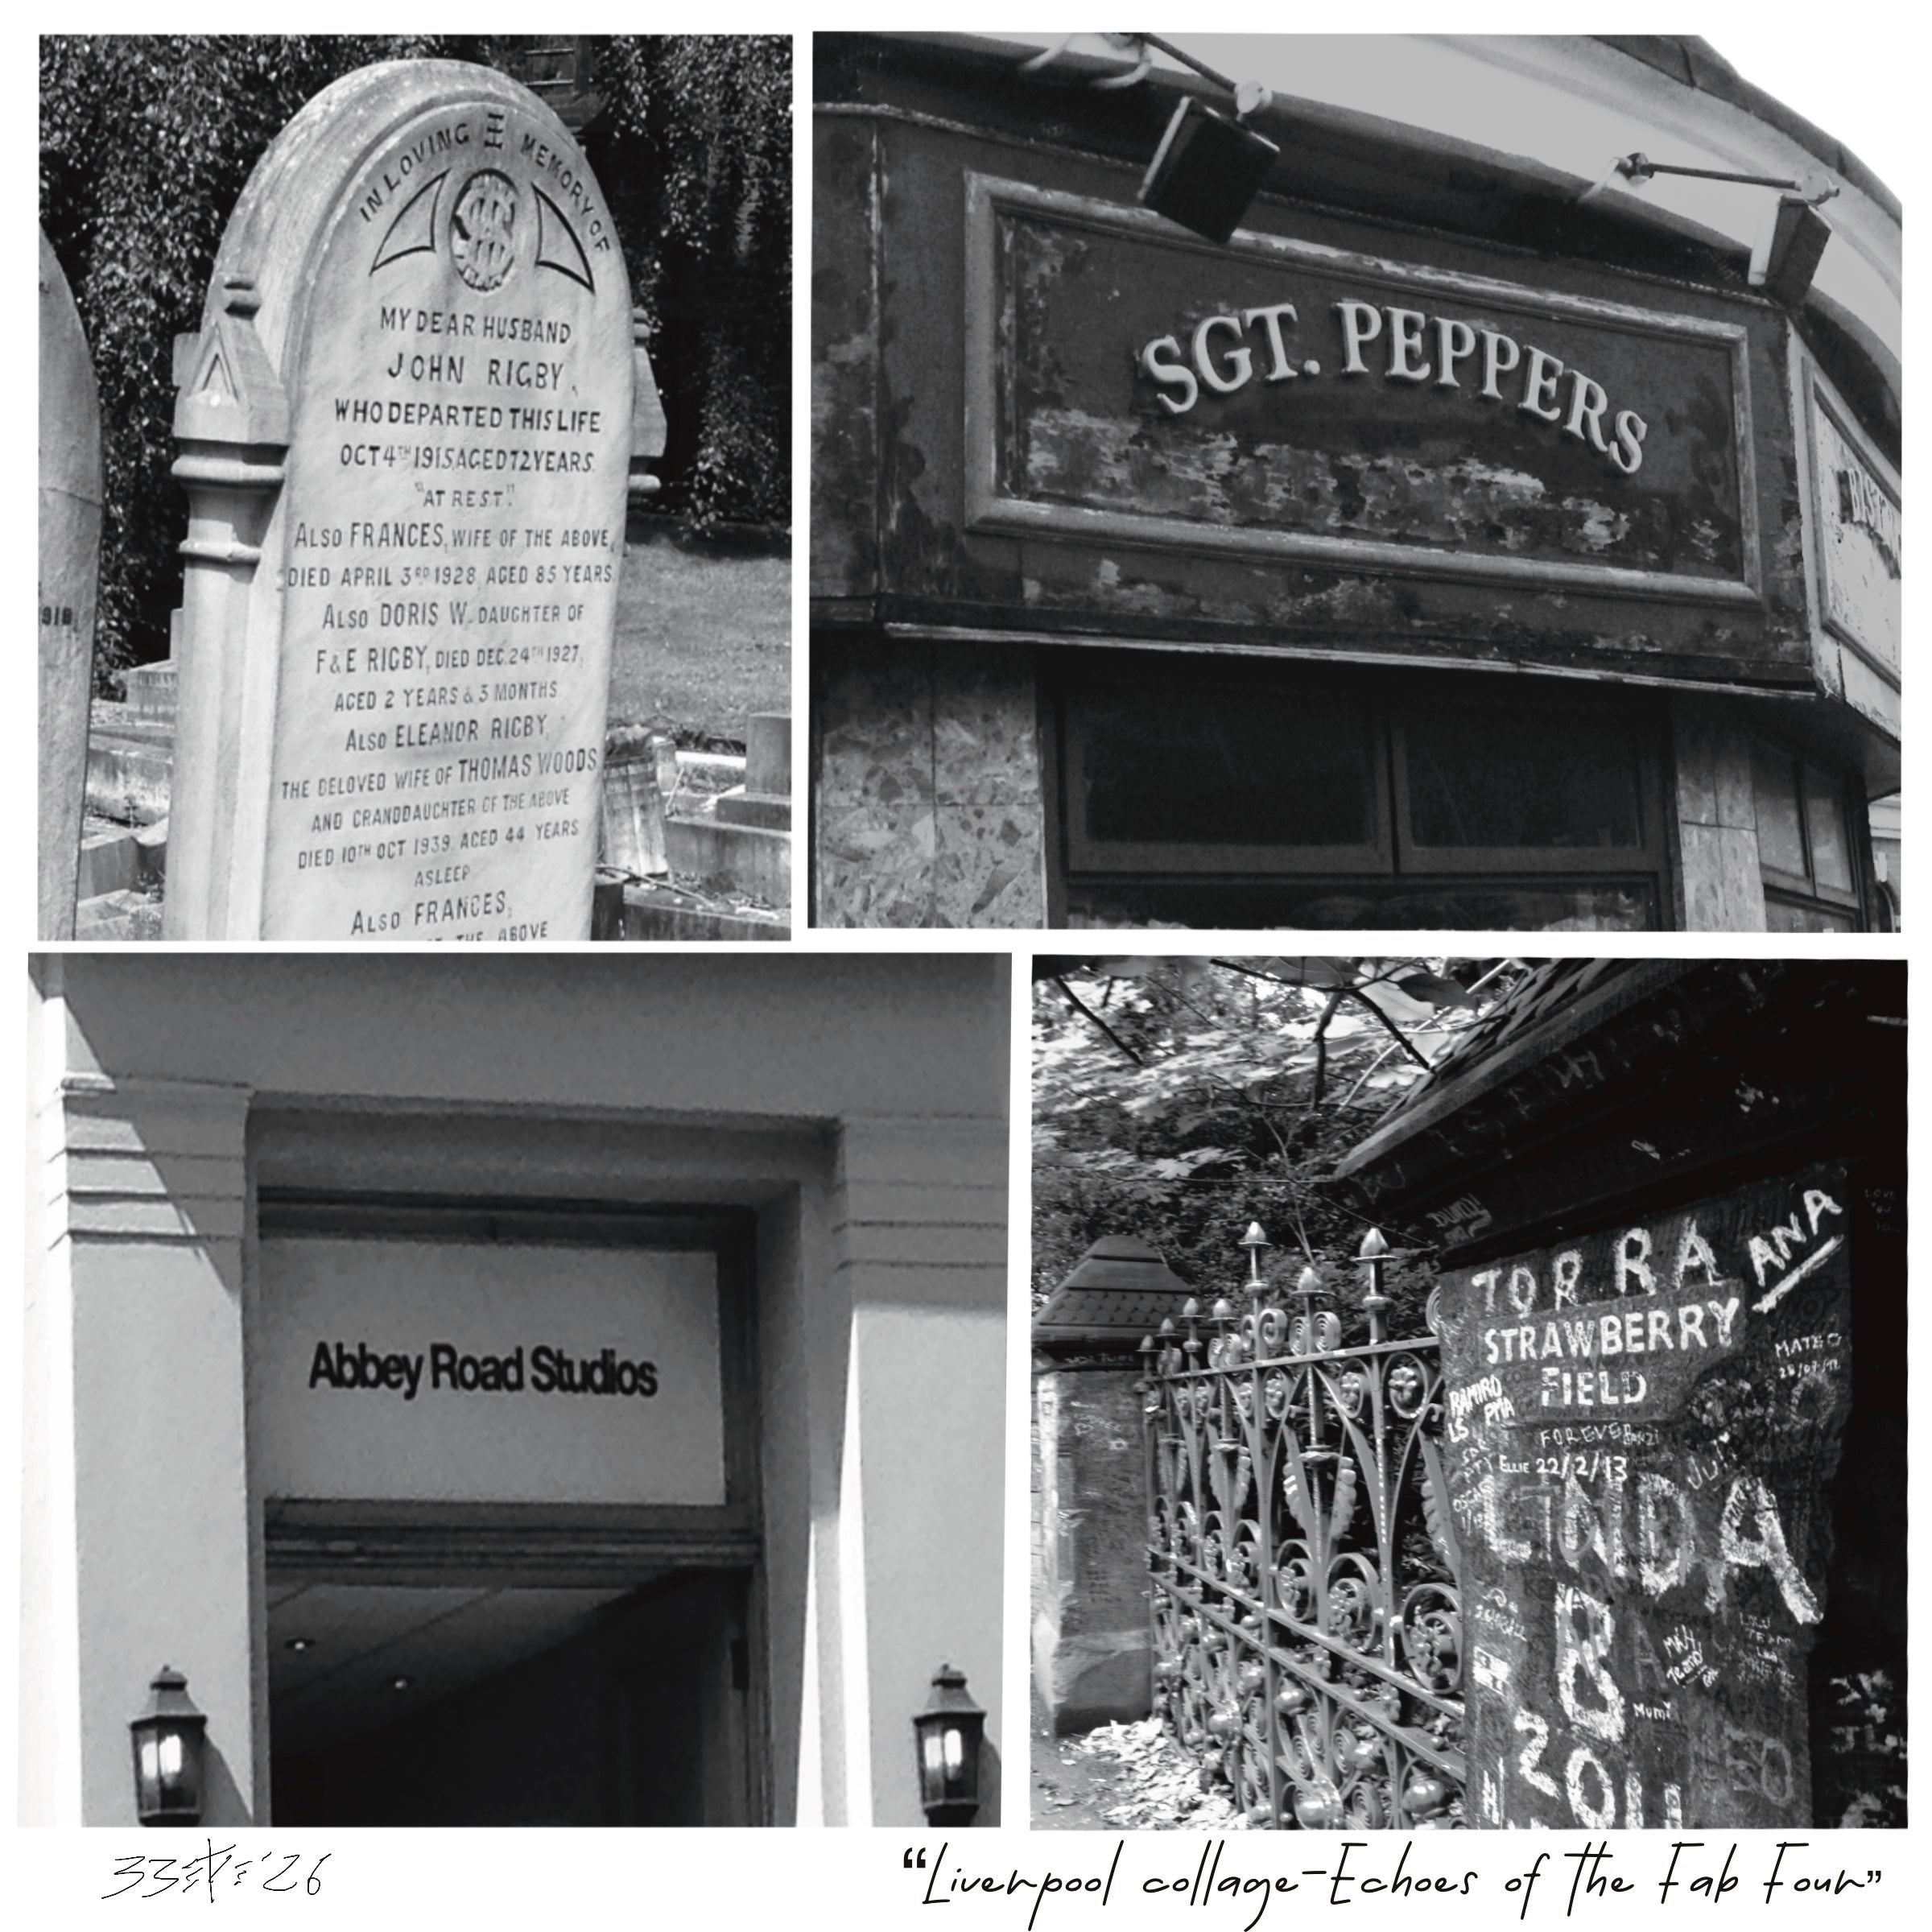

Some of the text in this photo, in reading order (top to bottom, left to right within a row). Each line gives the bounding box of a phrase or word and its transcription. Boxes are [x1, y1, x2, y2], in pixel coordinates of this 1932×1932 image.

[359, 122, 610, 252] IN LOVING MEMORY OF
[380, 306, 572, 345] MY DEAR HUSBAND
[387, 352, 464, 384] JOHN
[1141, 301, 1648, 474] SGT. PEPPERS
[335, 399, 601, 433] WHO DEPARTED THIS LIFE
[341, 444, 380, 466] OCT
[456, 448, 506, 470] AGED
[510, 450, 531, 471] 72
[452, 529, 491, 547] WIFE
[500, 529, 518, 547] OF
[525, 529, 553, 547] THE
[288, 567, 330, 587] DIED
[341, 567, 392, 587] APRIL
[486, 566, 528, 585] AGED
[535, 565, 556, 583] 85
[381, 603, 438, 626] DORIS
[479, 605, 560, 624] DAUGHTER
[568, 605, 585, 621] OF
[435, 649, 469, 669] DIED
[335, 691, 377, 712] AGED
[384, 690, 395, 708] 2
[403, 686, 458, 708] YEARS
[494, 680, 558, 702] MONTHS
[394, 719, 479, 749] ELEANOR
[283, 778, 311, 799] THE
[319, 772, 386, 797] BELOVED
[394, 767, 431, 790] WIFE
[436, 766, 453, 786] OF
[458, 753, 531, 782] THOMAS
[312, 811, 343, 832] AND
[482, 795, 497, 813] OF
[502, 792, 525, 811] THE
[530, 788, 570, 809] ABOVE
[299, 848, 334, 869] DIED
[377, 839, 407, 860] OCT
[460, 828, 498, 849] AGED
[506, 826, 526, 844] 44
[535, 819, 580, 840] YEARS
[415, 864, 470, 887] ASLEEP
[1748, 1189, 1844, 1288] ANA
[1484, 1297, 1740, 1366] STRAWBERRY
[1774, 1332, 1843, 1358] MATEO
[309, 1340, 659, 1401] Abbey Road Studios
[1540, 1366, 1648, 1408] FIELD
[1448, 1373, 1504, 1419] RAMIRO
[1534, 1451, 1629, 1483] 22/2/13
[1484, 1472, 1824, 1625] LINDA
